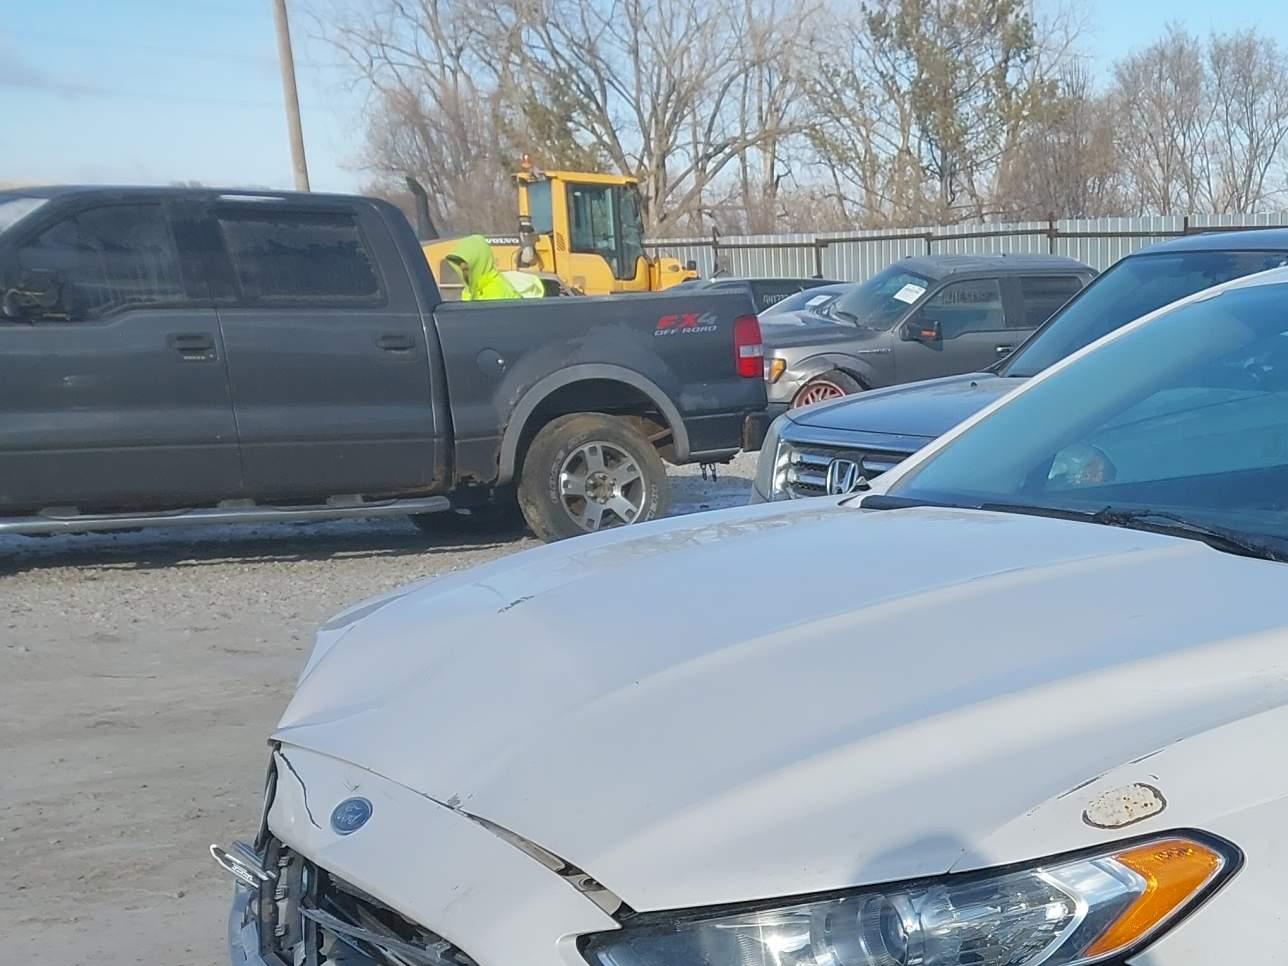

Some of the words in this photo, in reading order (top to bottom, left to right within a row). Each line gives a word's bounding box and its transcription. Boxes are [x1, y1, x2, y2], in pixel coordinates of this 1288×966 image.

[656, 312, 717, 329] FX4
[654, 328, 677, 337] OFF
[682, 325, 717, 333] ROAD
